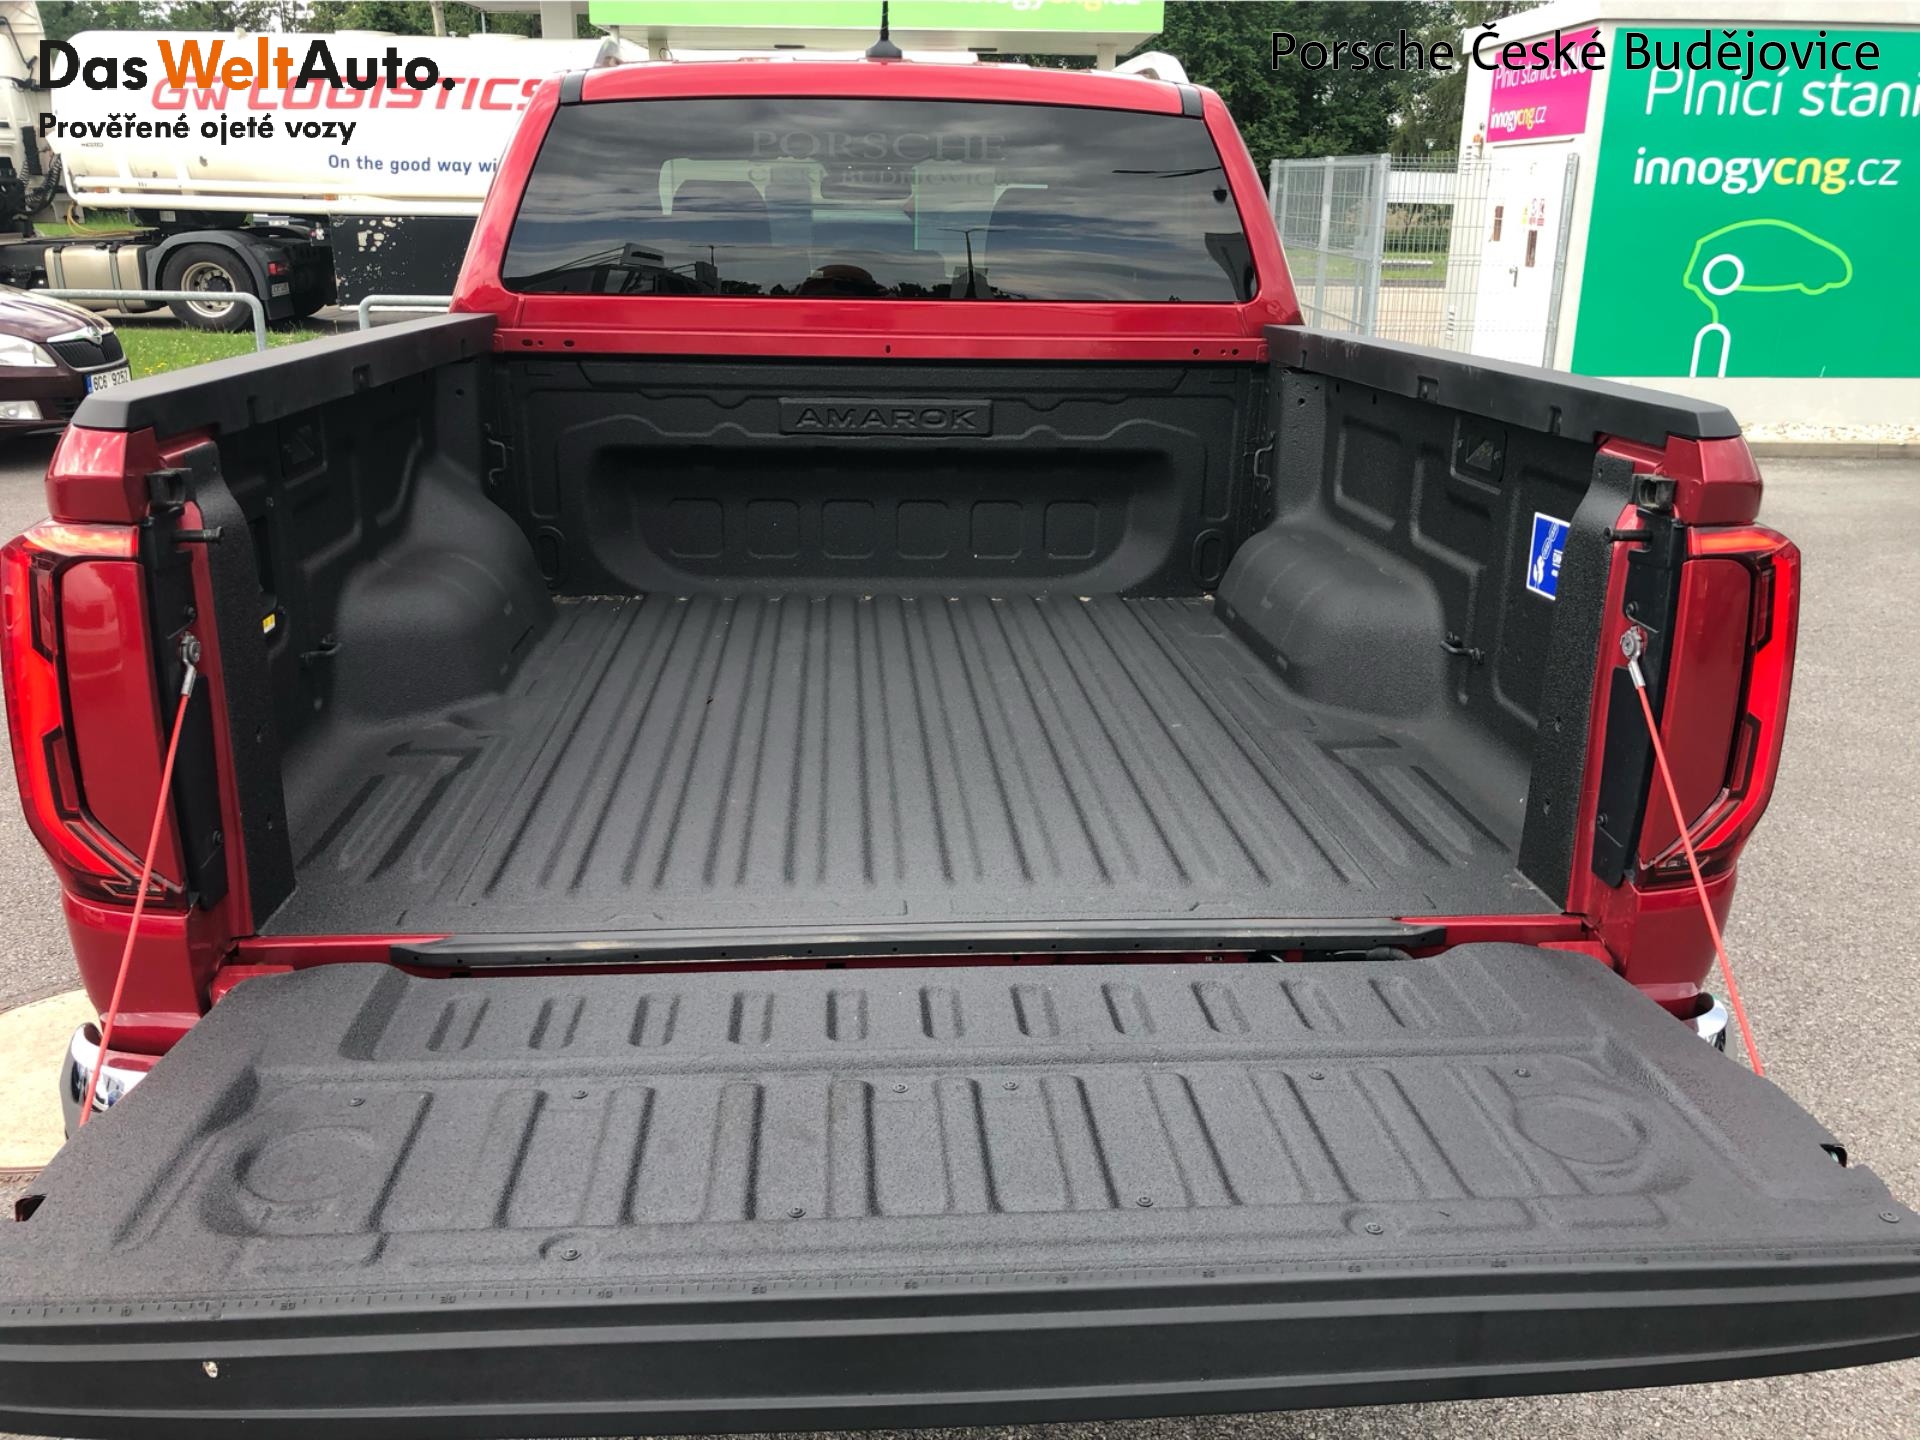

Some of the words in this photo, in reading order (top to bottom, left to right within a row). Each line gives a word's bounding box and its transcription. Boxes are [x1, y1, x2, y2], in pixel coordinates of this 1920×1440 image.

[1645, 65, 1790, 115] Plnicí
[750, 130, 1007, 161] PORSCHE
[328, 154, 350, 168] On
[356, 156, 383, 170] the
[390, 157, 431, 175] good
[437, 160, 472, 175] way
[1633, 147, 1902, 195] innogycng.cz
[796, 407, 977, 430] AMAROK
